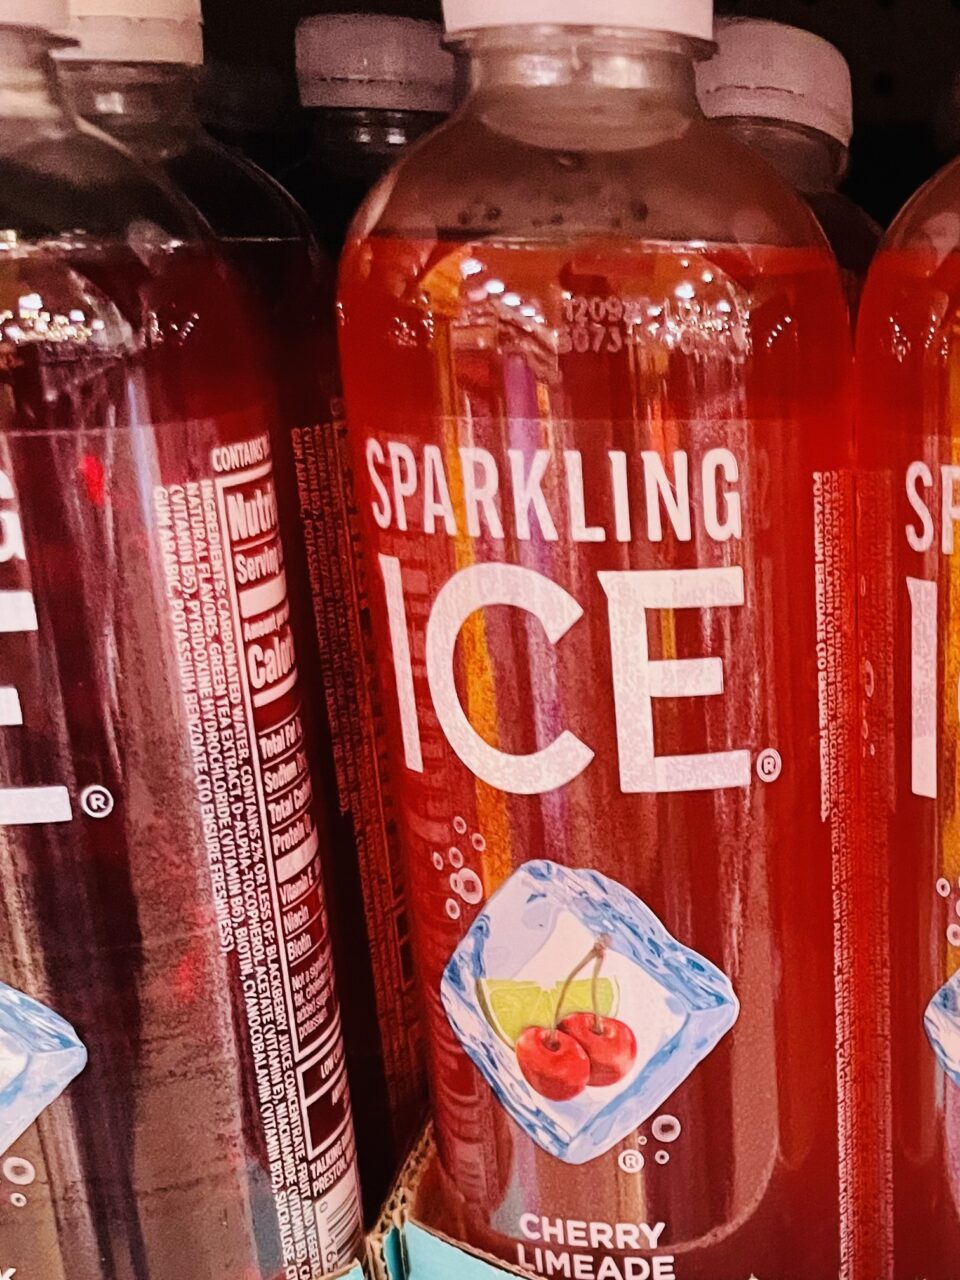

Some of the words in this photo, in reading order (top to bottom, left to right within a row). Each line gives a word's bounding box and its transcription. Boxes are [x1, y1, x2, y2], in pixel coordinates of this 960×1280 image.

[366, 437, 742, 543] SPARKLING
[216, 698, 232, 728] TEA
[232, 705, 250, 764] WATER,
[221, 730, 242, 801] EXTRACT,
[240, 766, 261, 839] CONTAINS
[249, 840, 263, 862] 2%
[254, 866, 267, 885] OR
[255, 887, 272, 919] LESS
[236, 927, 254, 979] BIOTIN,
[254, 966, 275, 1022] ACETATE
[265, 945, 288, 1030] BLACKBERRY
[276, 1034, 294, 1068] JUICE
[275, 1102, 298, 1185] NIACINAMIDE
[282, 1071, 306, 1163] CONCENTRATE,
[520, 1212, 665, 1249] CHERRY
